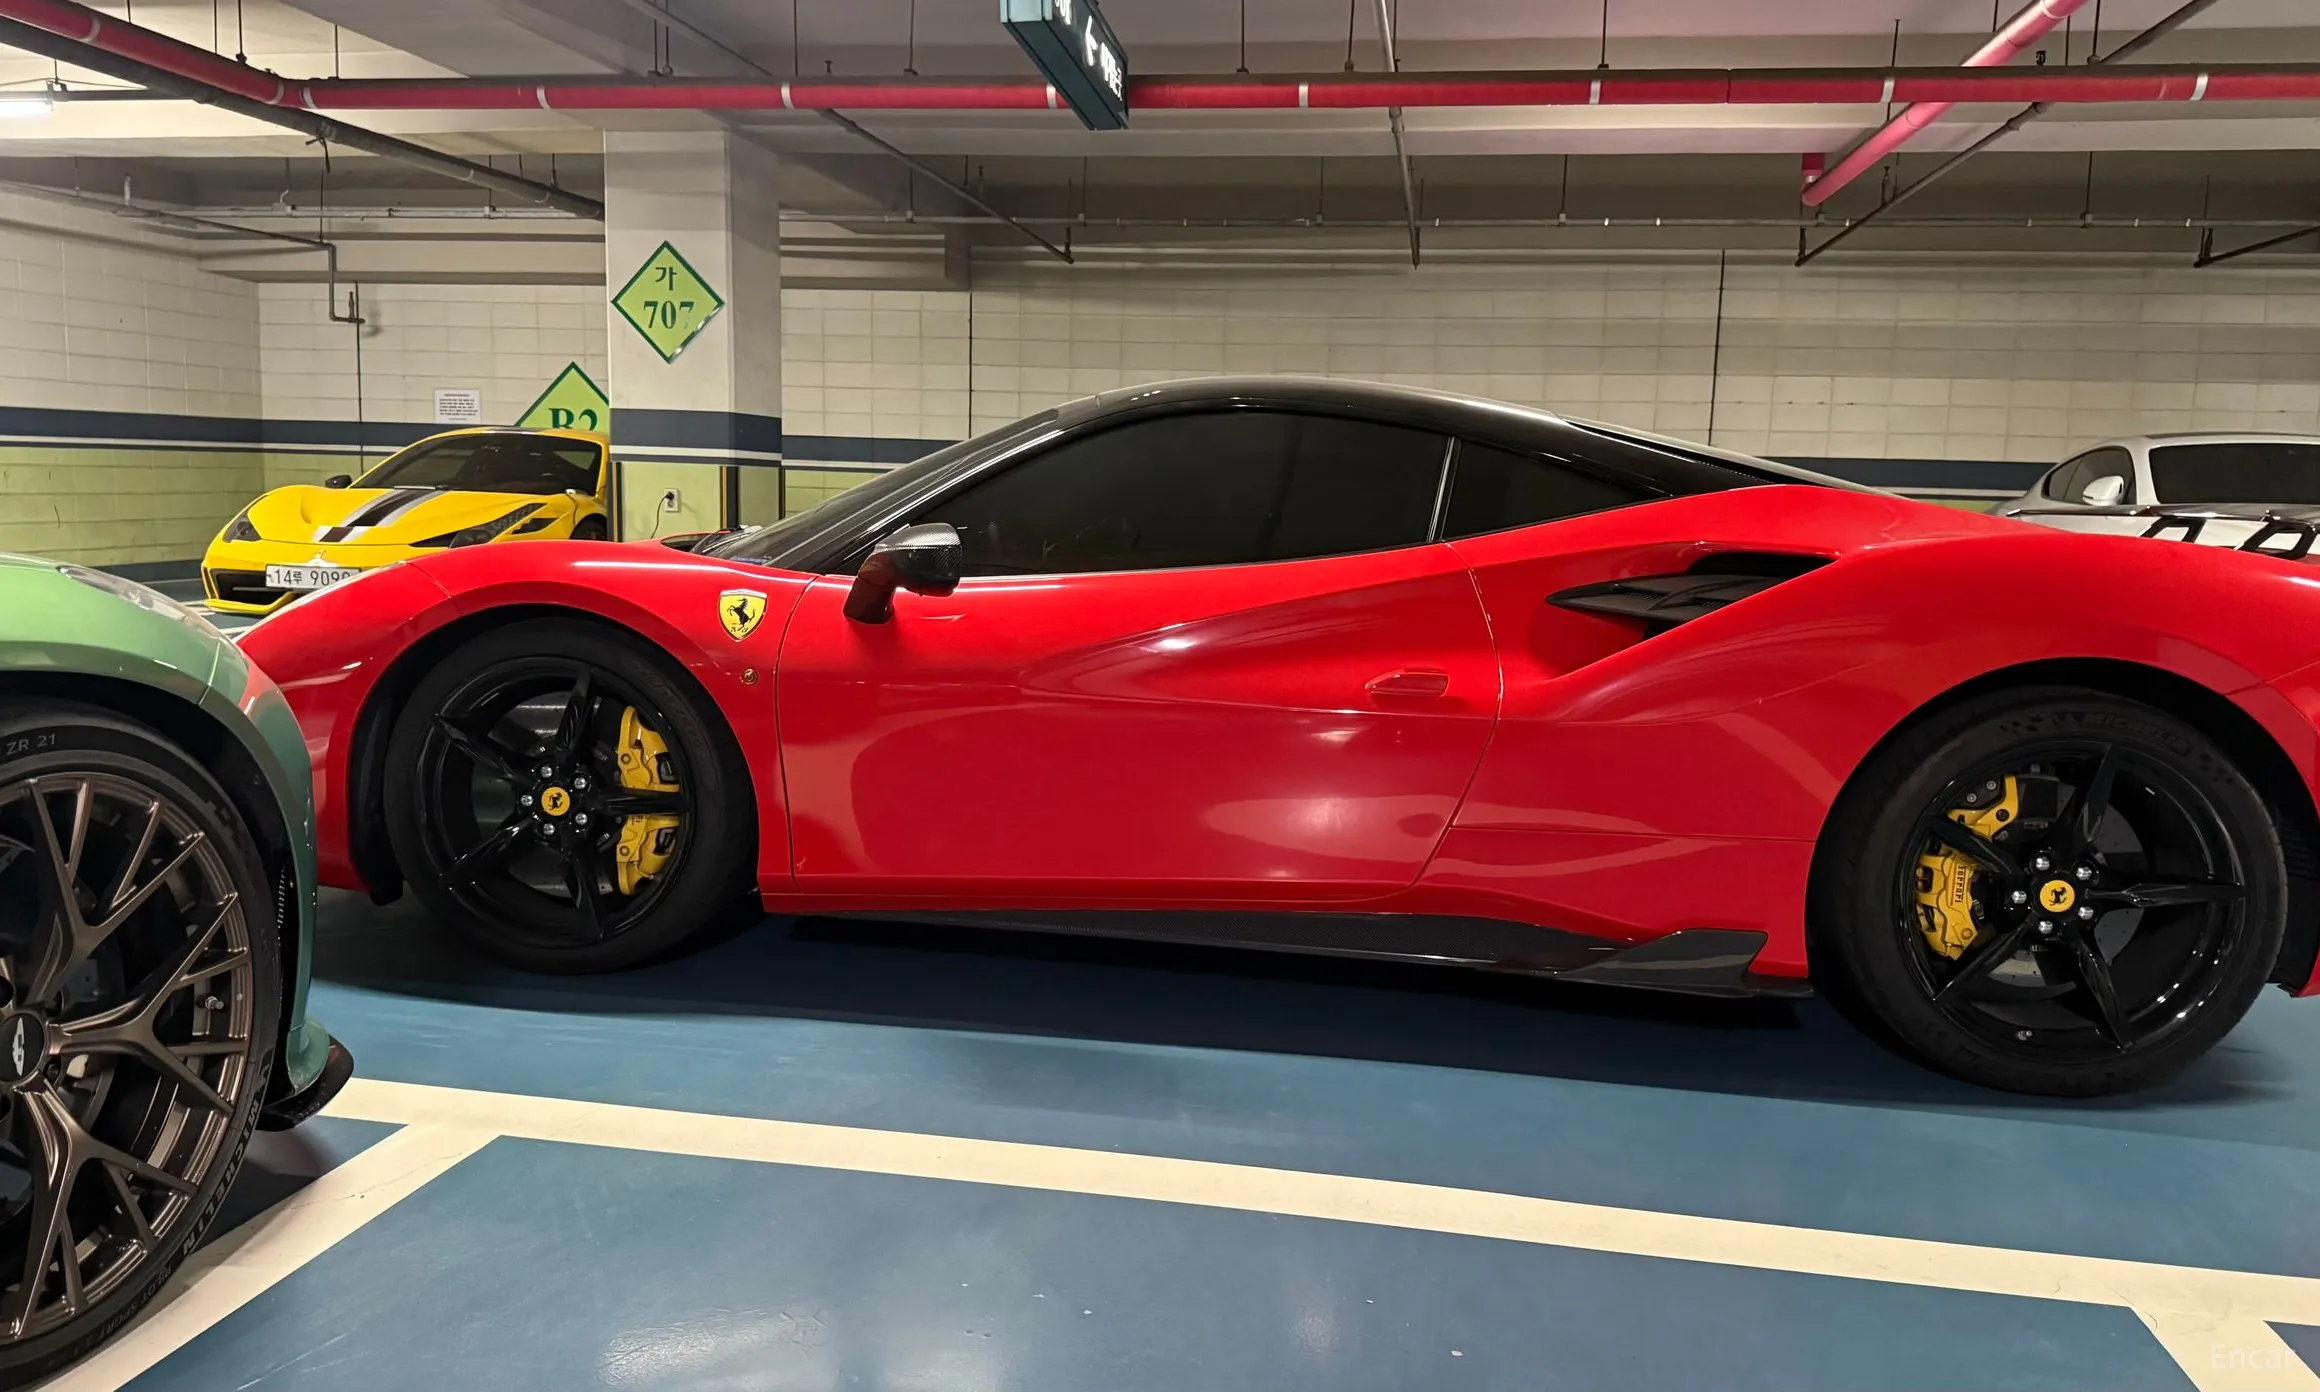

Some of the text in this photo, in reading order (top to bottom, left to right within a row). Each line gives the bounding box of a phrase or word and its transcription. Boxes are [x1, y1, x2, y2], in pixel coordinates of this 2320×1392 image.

[655, 266, 677, 291] 가
[643, 300, 694, 329] 707
[275, 568, 302, 584] 14루
[6, 732, 56, 755] ZR 21
[183, 1099, 259, 1256] MICHELIN
